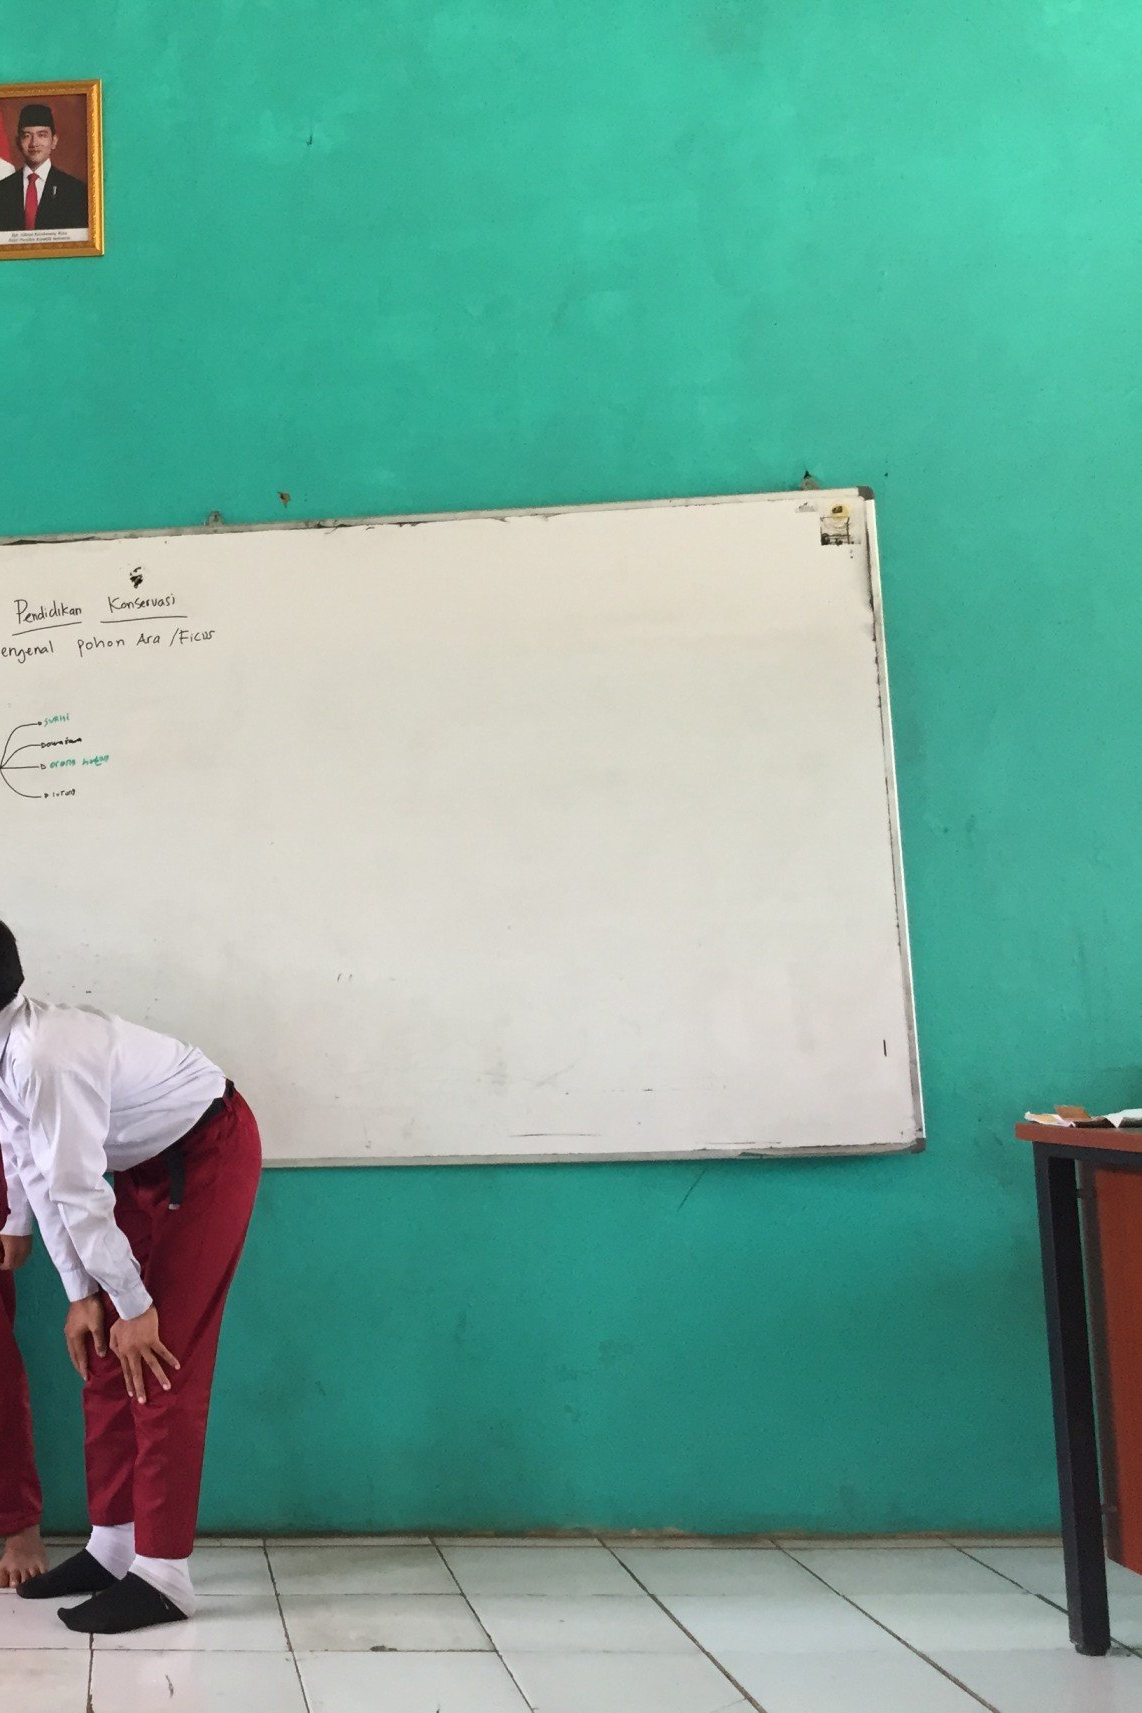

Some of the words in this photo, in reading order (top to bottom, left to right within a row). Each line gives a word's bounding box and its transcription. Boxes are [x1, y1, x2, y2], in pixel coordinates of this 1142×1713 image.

[14, 599, 82, 625] Pendidikan
[107, 593, 176, 613] Konservasi
[137, 633, 161, 646] Ara
